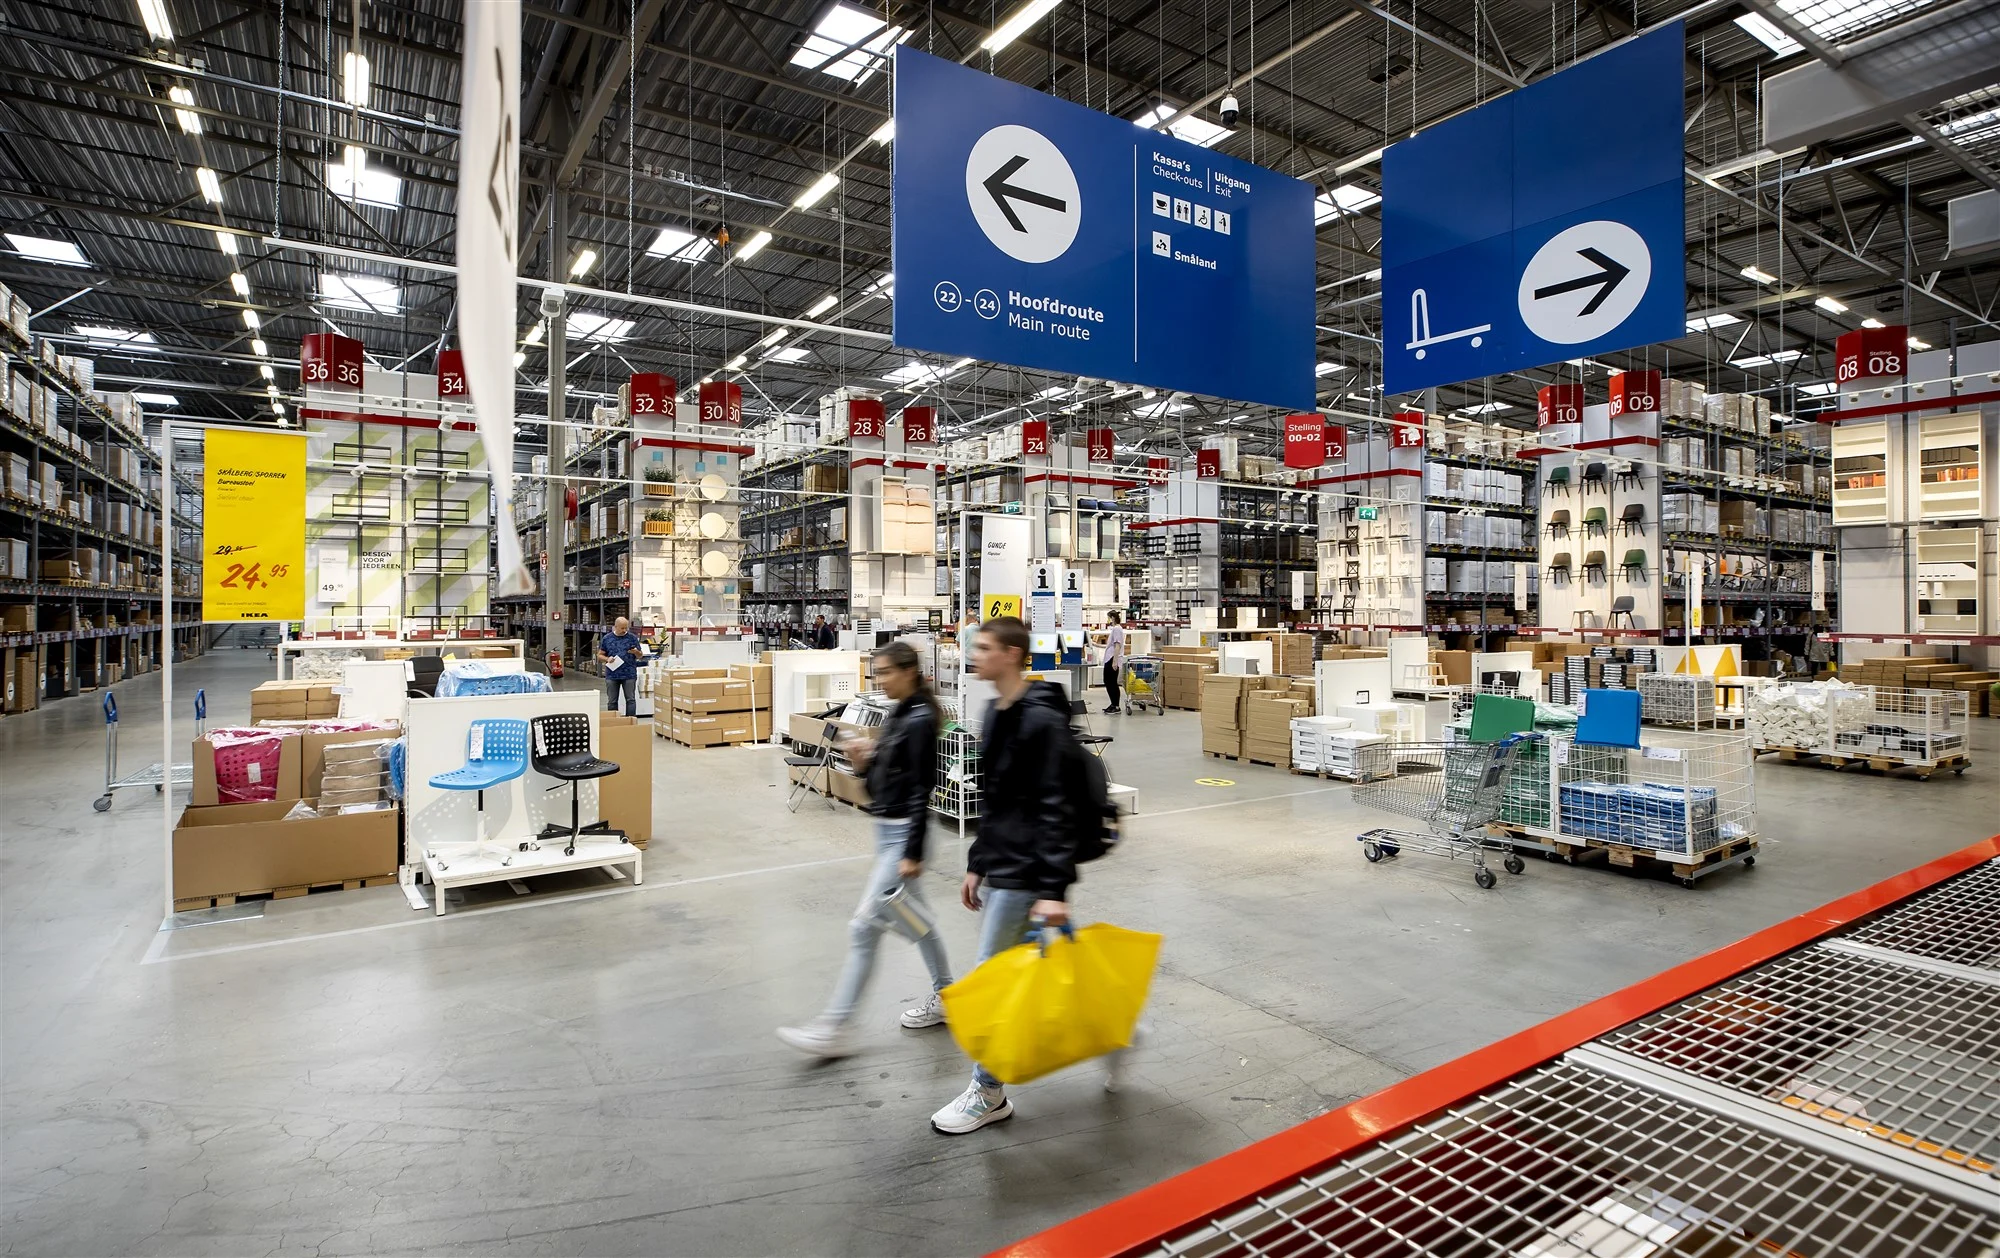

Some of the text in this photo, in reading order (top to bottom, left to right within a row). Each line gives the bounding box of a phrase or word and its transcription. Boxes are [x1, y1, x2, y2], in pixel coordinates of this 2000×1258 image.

[1153, 152, 1191, 172] Kassa's
[1153, 165, 1203, 188] Check-outs
[1214, 172, 1251, 193] Uitgang
[1215, 185, 1232, 198] Exit
[1174, 250, 1217, 270] Småland
[940, 290, 956, 304] 22
[980, 298, 996, 311] 24
[1008, 290, 1104, 322] Hoofdroute
[1008, 312, 1090, 340] Main route
[306, 362, 328, 380] 36
[1838, 360, 1858, 380] 08
[1868, 356, 1900, 374] 08
[338, 364, 360, 384] 36
[442, 378, 464, 394] 34
[635, 398, 655, 412] 32
[661, 399, 674, 416] 32
[1610, 398, 1622, 416] 09
[1629, 395, 1655, 410] 09
[704, 406, 723, 420] 30
[729, 406, 740, 423] 30
[1539, 410, 1549, 427] 10
[1556, 408, 1578, 422] 10
[853, 422, 872, 434] 28
[908, 428, 926, 440] 26
[1288, 424, 1321, 432] Stelling
[1288, 433, 1321, 442] 00-02
[1027, 441, 1044, 452] 24
[1092, 448, 1108, 460] 22
[1326, 446, 1342, 458] 12
[1201, 465, 1216, 476] 13
